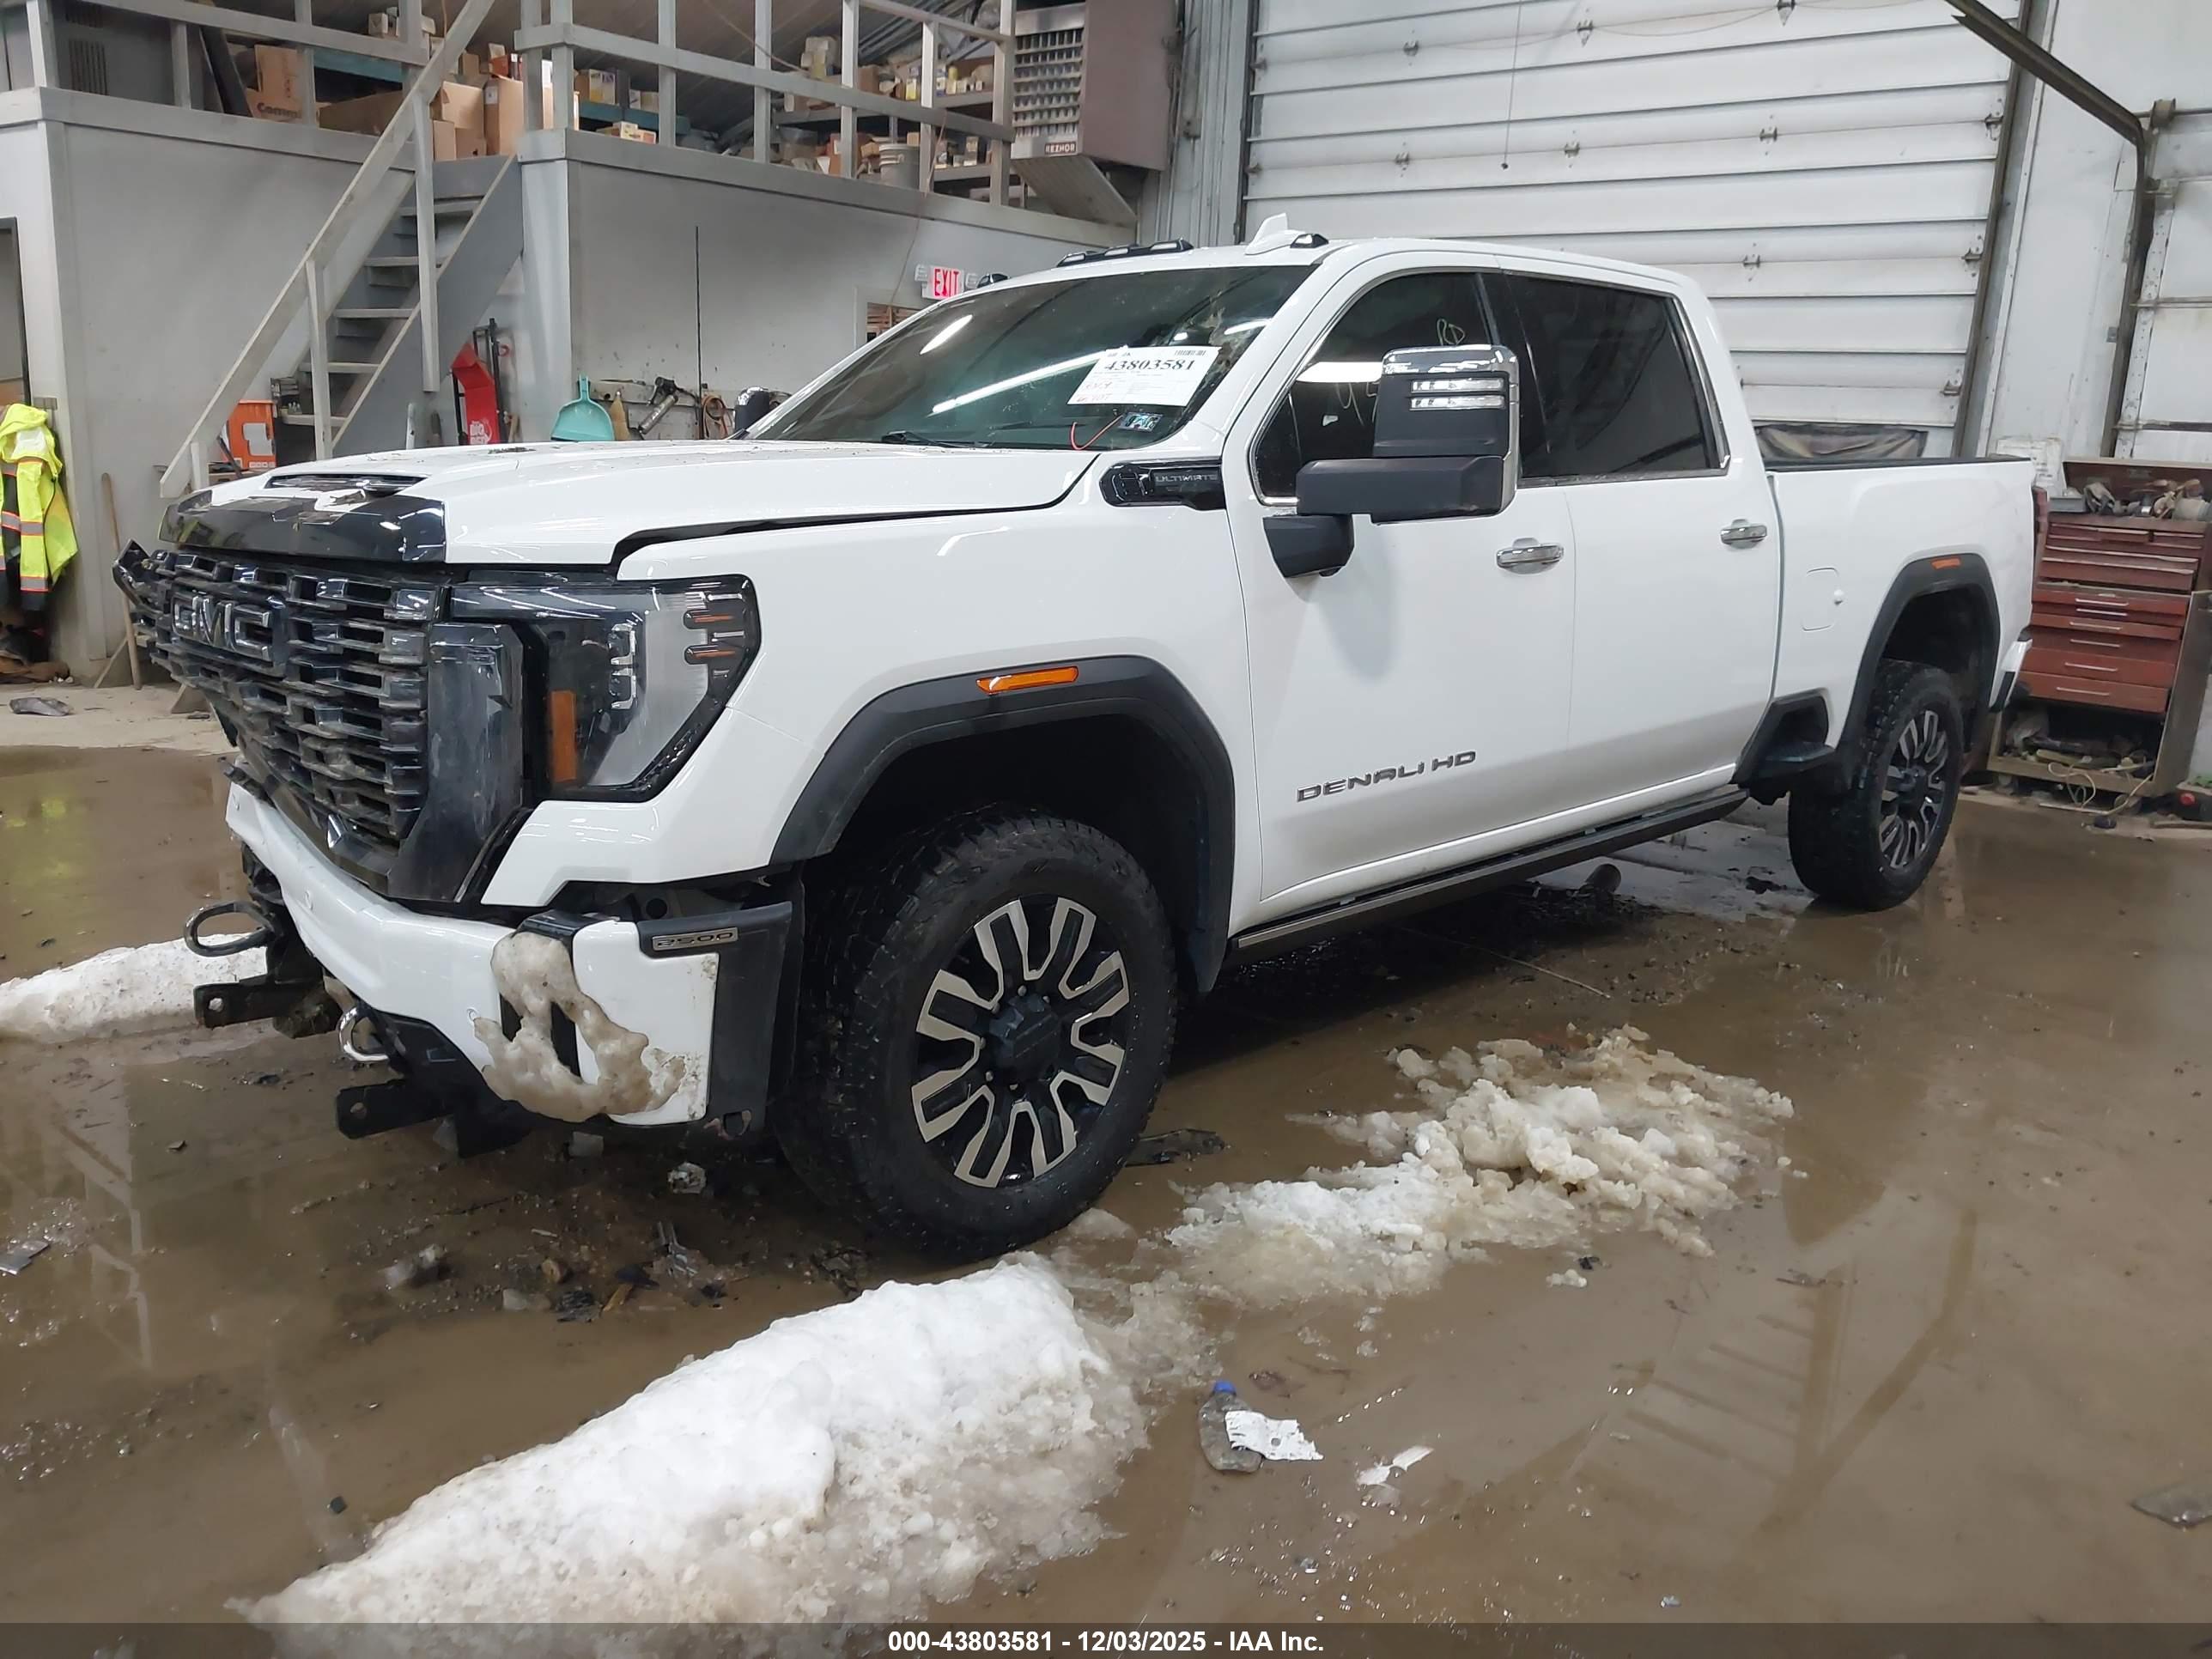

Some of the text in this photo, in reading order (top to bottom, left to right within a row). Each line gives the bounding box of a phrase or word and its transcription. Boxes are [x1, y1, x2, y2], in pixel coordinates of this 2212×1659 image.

[934, 267, 960, 298] EXIT
[1104, 358, 1196, 372] 43803581
[173, 591, 272, 660] GMC
[1296, 750, 1476, 802] DENALI HD
